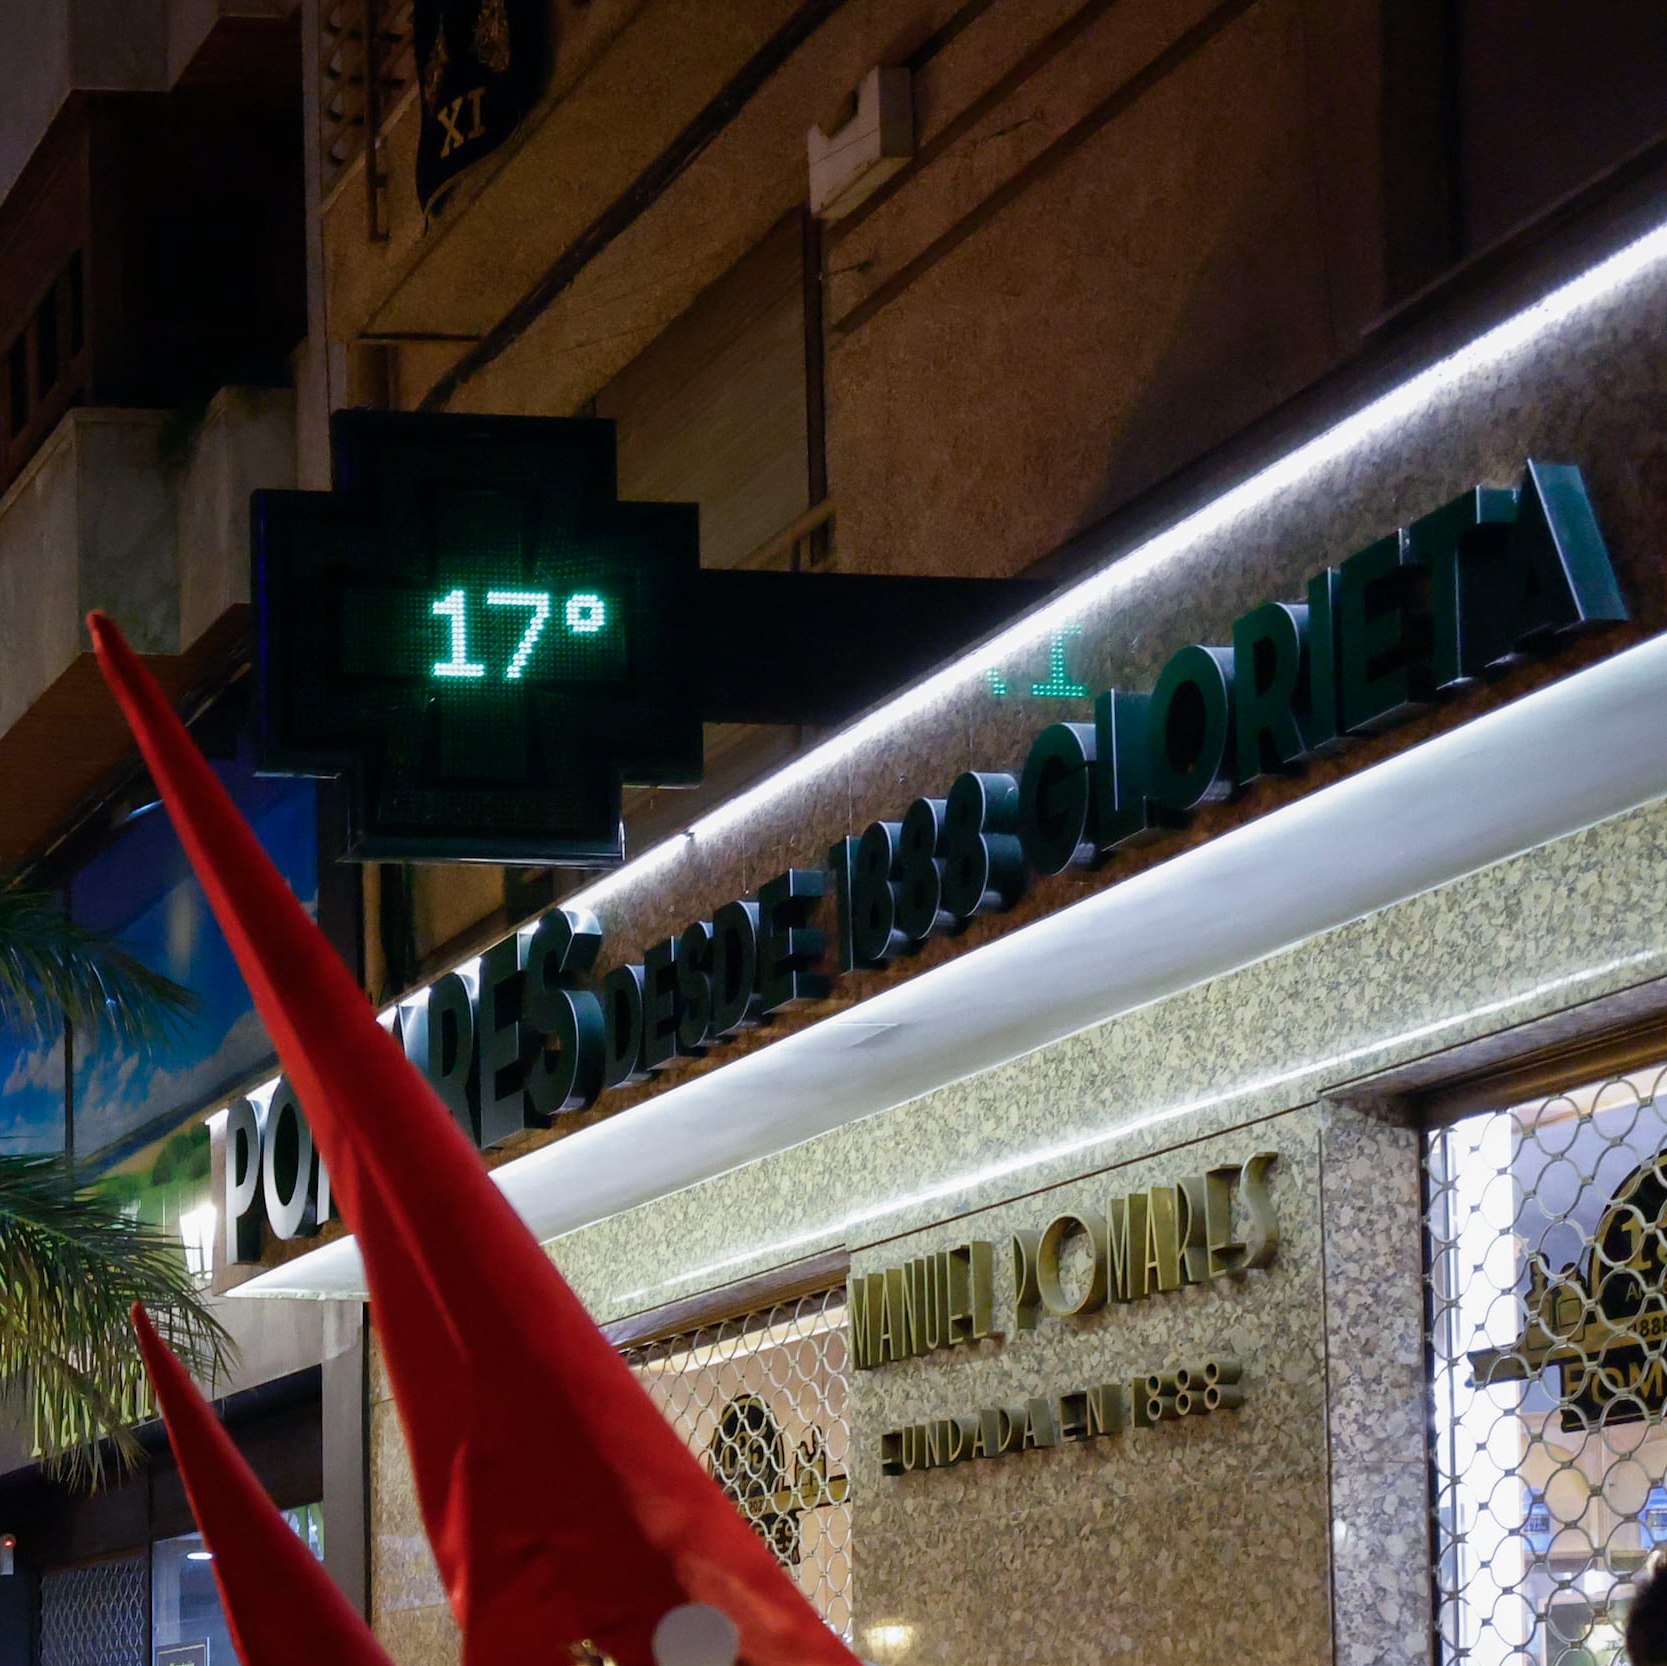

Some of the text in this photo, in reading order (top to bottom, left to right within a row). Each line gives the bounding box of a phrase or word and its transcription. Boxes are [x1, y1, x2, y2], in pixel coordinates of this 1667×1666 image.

[436, 85, 489, 159] XI
[227, 458, 1629, 1264] PORES DESDE 1888 GLORIETA
[849, 1151, 1279, 1371] MANUEL POMARES
[881, 1358, 1244, 1477] FUNDADA EN 1888
